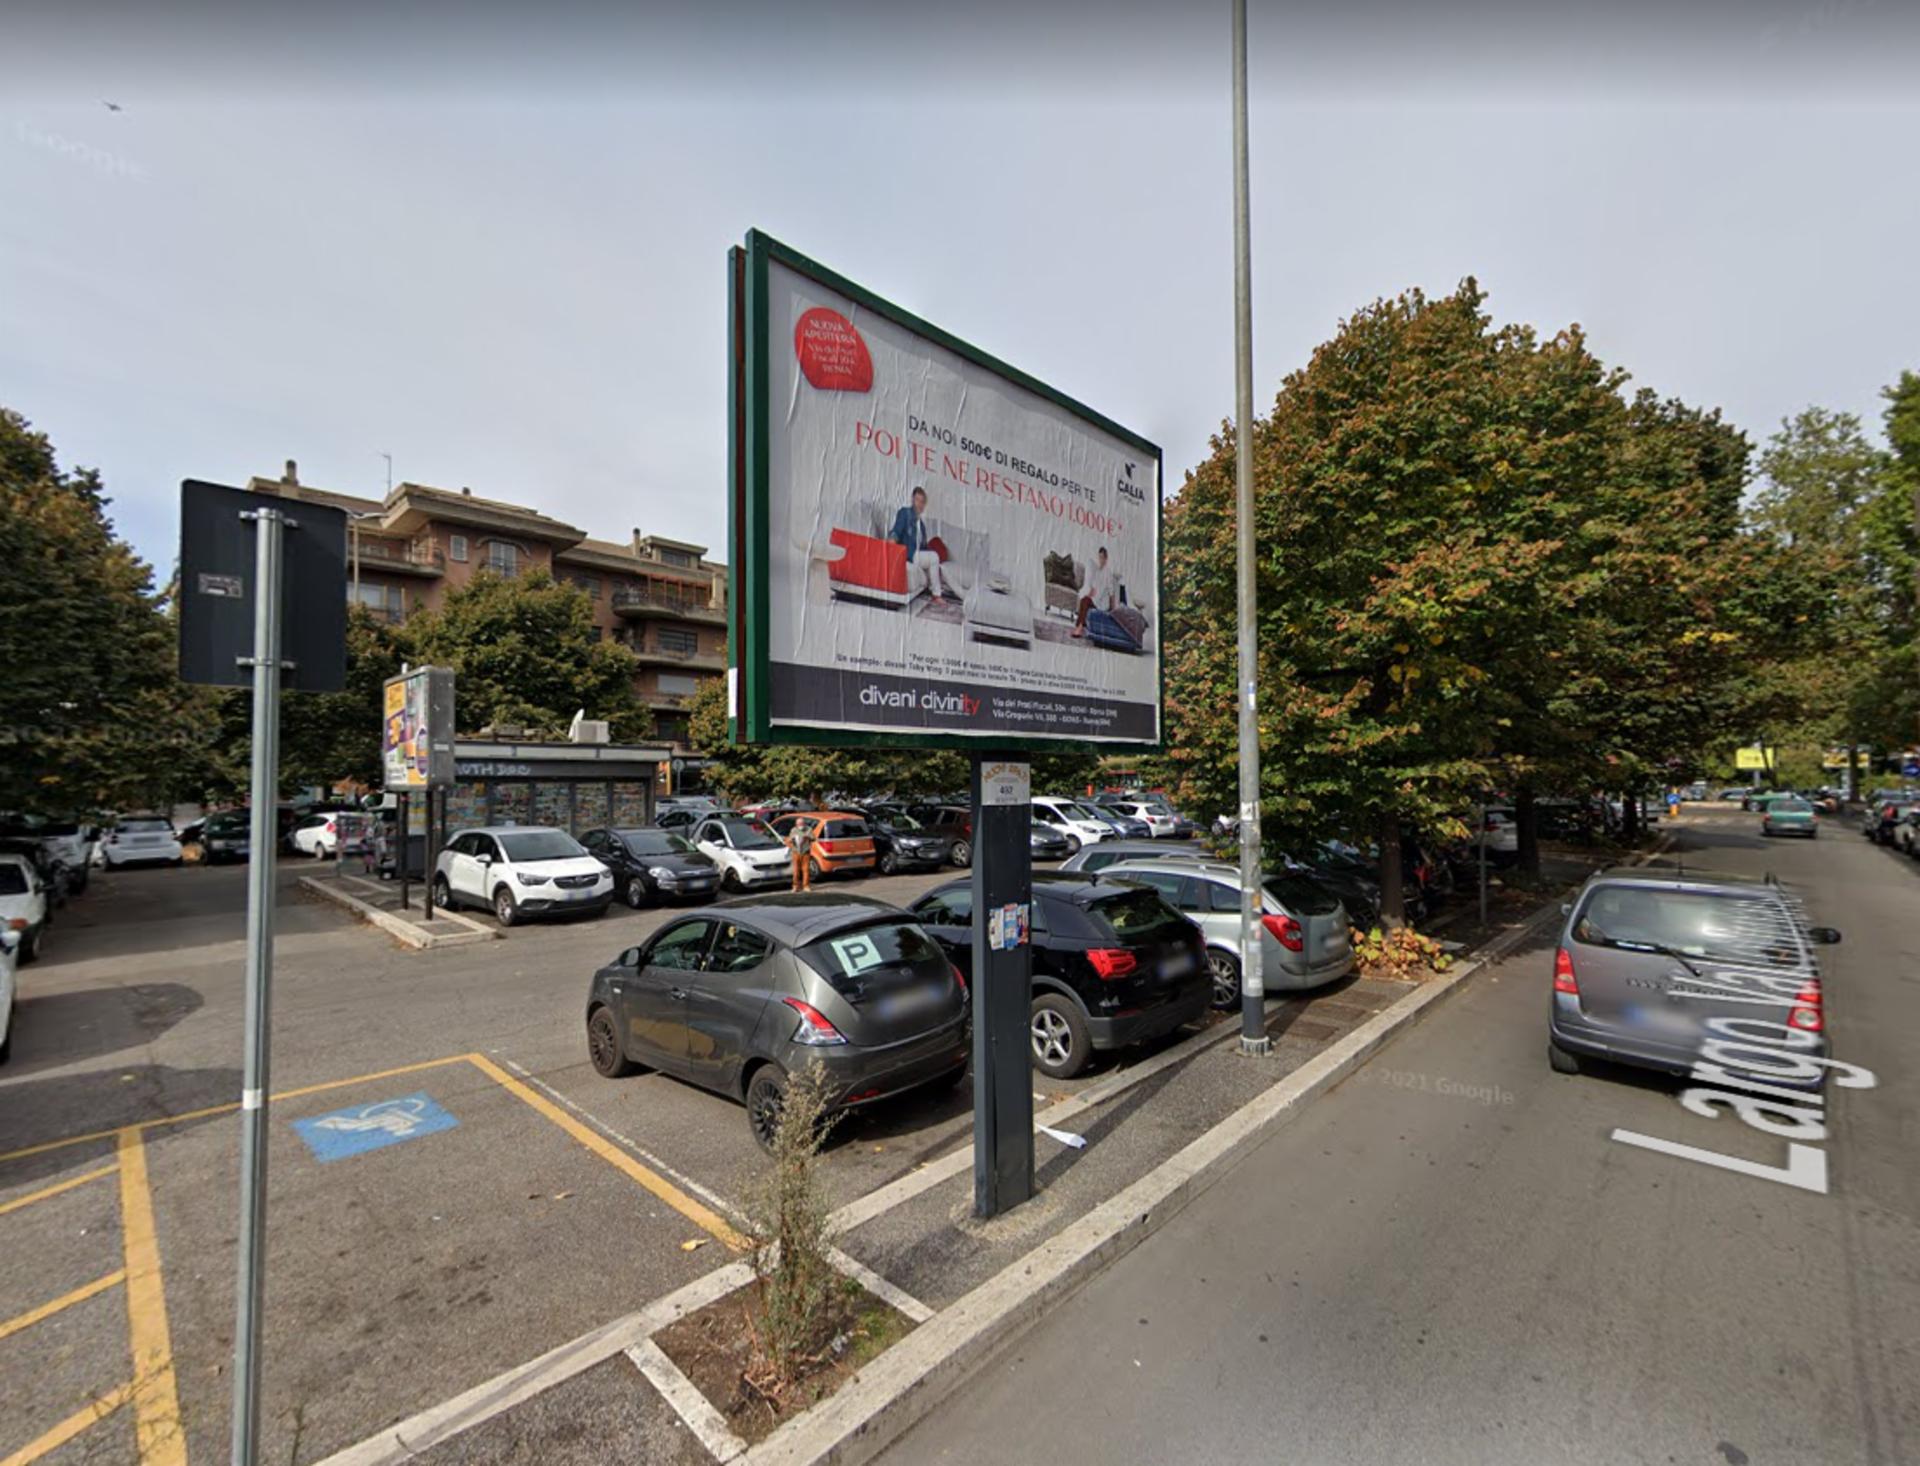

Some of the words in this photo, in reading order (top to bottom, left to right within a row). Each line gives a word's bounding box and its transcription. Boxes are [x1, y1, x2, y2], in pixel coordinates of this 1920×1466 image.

[856, 421, 900, 460] POI
[910, 441, 937, 473] TE
[943, 453, 970, 485] NE
[976, 467, 1064, 518] RESTANO
[909, 415, 930, 437] DA
[932, 425, 957, 446] NOI
[961, 437, 992, 460] 500€
[995, 451, 1008, 467] DI
[1011, 457, 1059, 486] REGALO
[1061, 477, 1081, 497] PER
[1084, 487, 1097, 503] TE
[1117, 479, 1145, 502] CALIA
[992, 697, 1004, 707] Via
[992, 708, 1004, 718] Via
[841, 943, 869, 970] P
